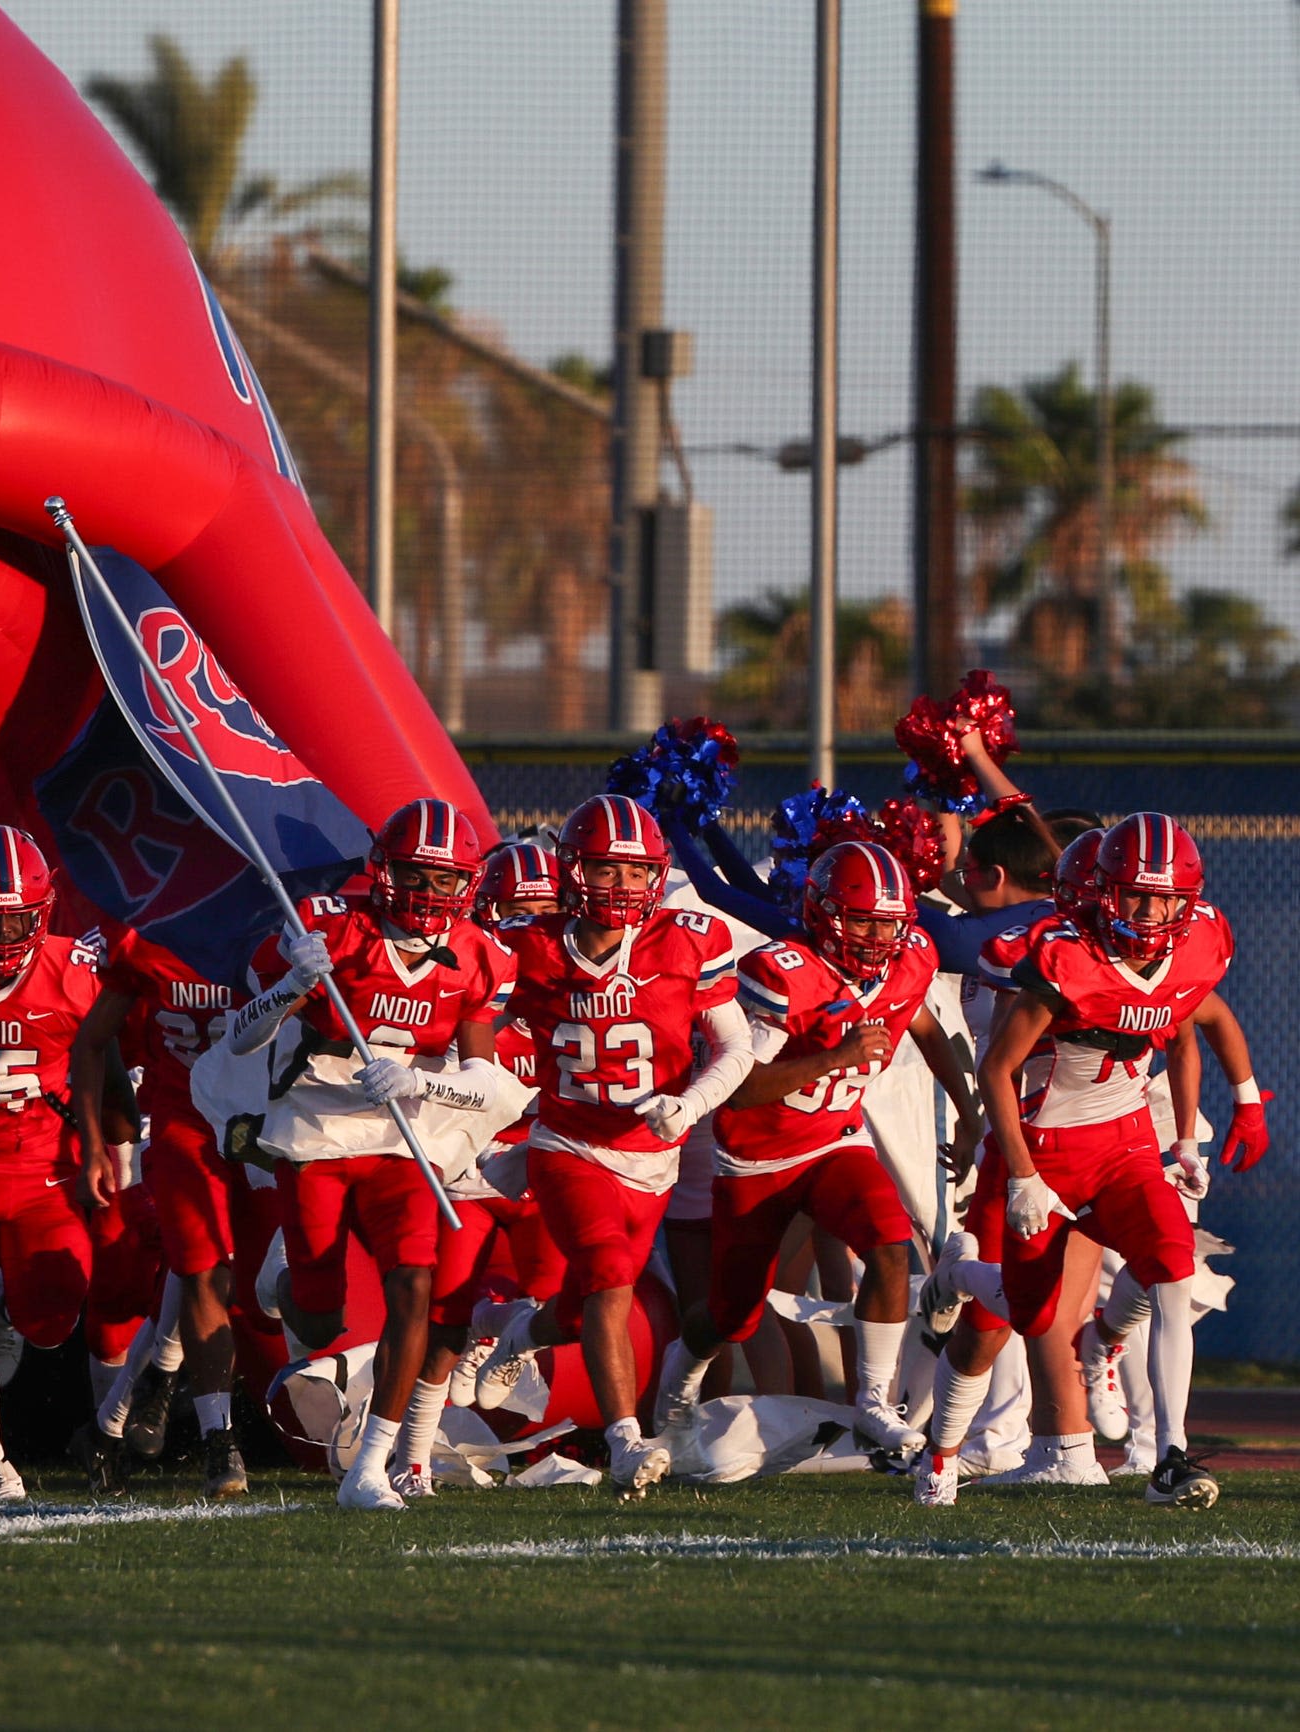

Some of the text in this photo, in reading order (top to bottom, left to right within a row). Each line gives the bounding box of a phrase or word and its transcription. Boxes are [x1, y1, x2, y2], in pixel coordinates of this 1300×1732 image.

[1139, 875, 1169, 884] Riddell
[172, 981, 232, 1009] INDIO
[258, 997, 273, 1016] For
[570, 992, 632, 1019] INDIO
[369, 992, 433, 1027] INDIO
[1117, 1005, 1173, 1032] INDIO
[552, 1021, 655, 1108] 23
